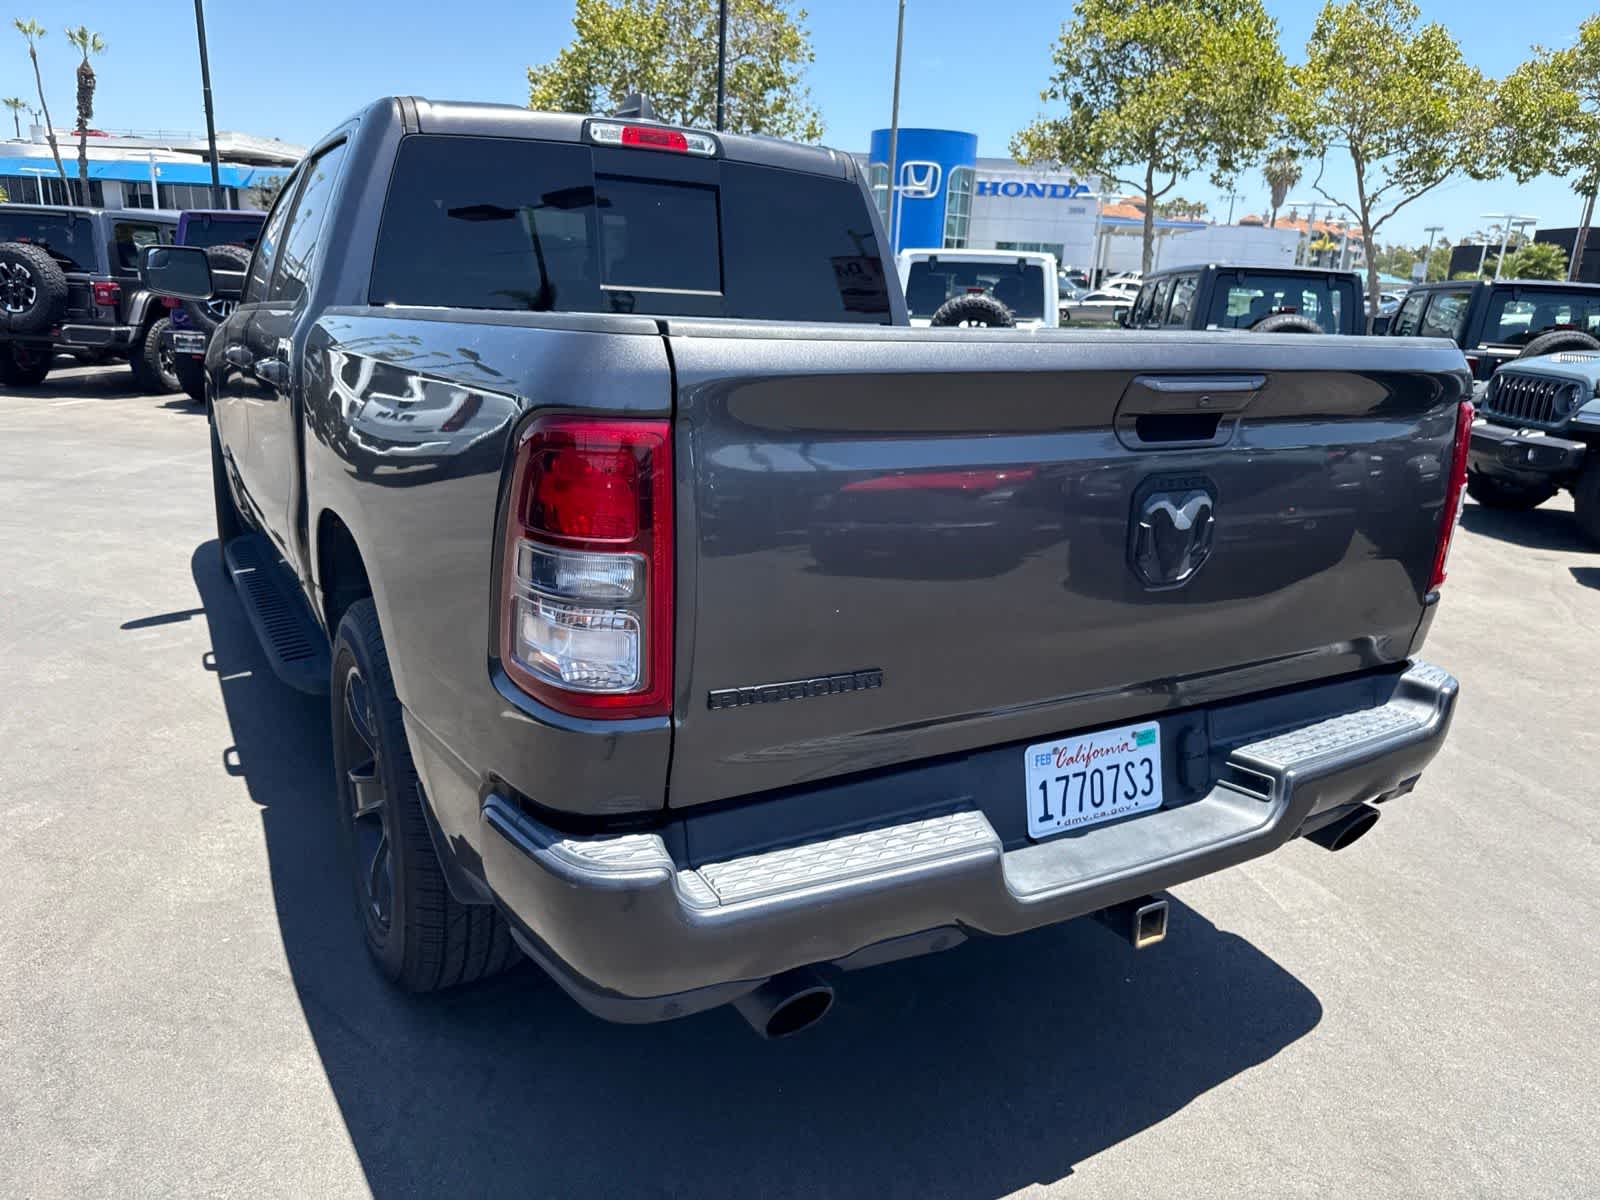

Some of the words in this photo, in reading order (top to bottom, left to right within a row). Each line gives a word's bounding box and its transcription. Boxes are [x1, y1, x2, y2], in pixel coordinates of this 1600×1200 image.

[976, 181, 1091, 199] HONDA
[1035, 753, 1051, 767] FEB
[1056, 738, 1137, 768] California
[1038, 757, 1154, 823] 17707S3
